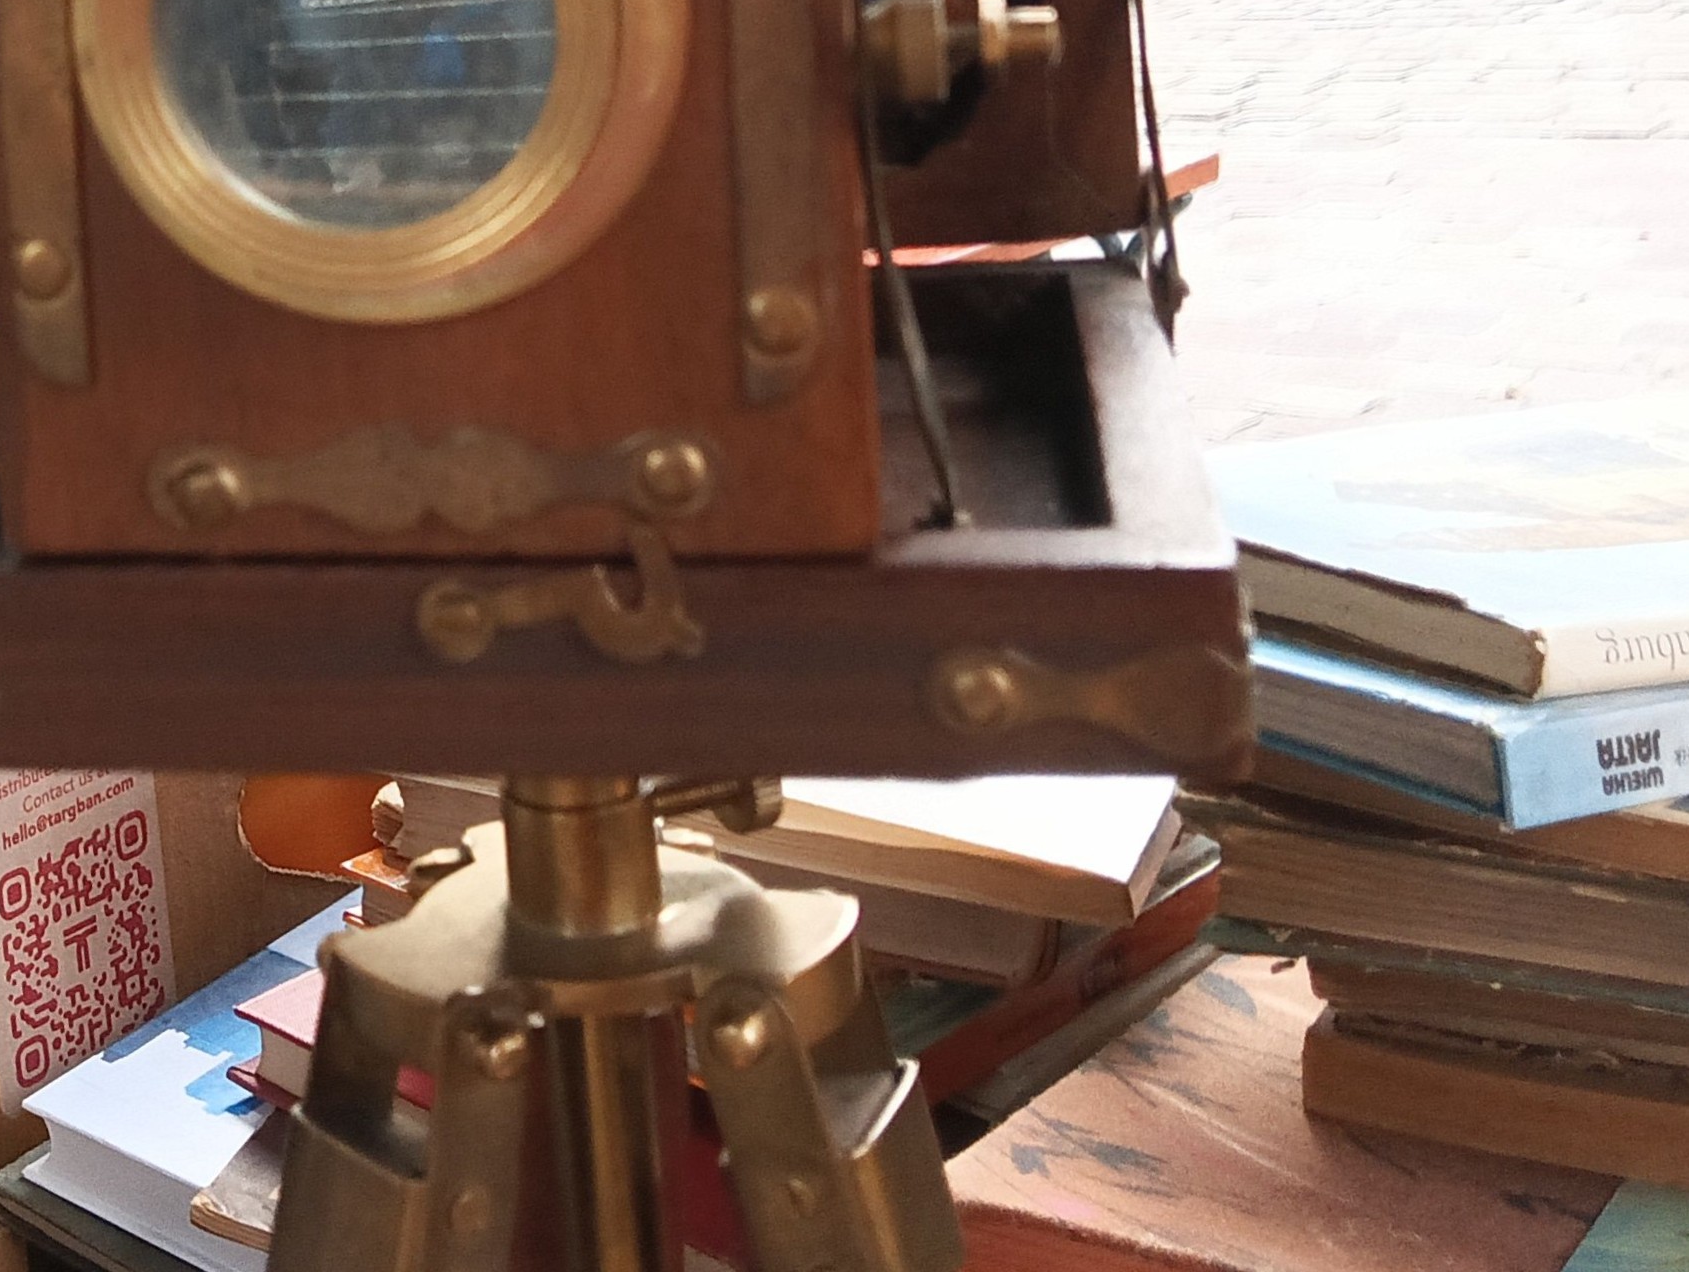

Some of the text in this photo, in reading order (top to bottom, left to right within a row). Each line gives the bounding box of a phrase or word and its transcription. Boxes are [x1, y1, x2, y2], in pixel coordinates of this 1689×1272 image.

[23, 777, 75, 814] Contact
[79, 770, 94, 787] us
[1602, 765, 1665, 796] WIELKA
[2, 776, 135, 850] hello@targban.com
